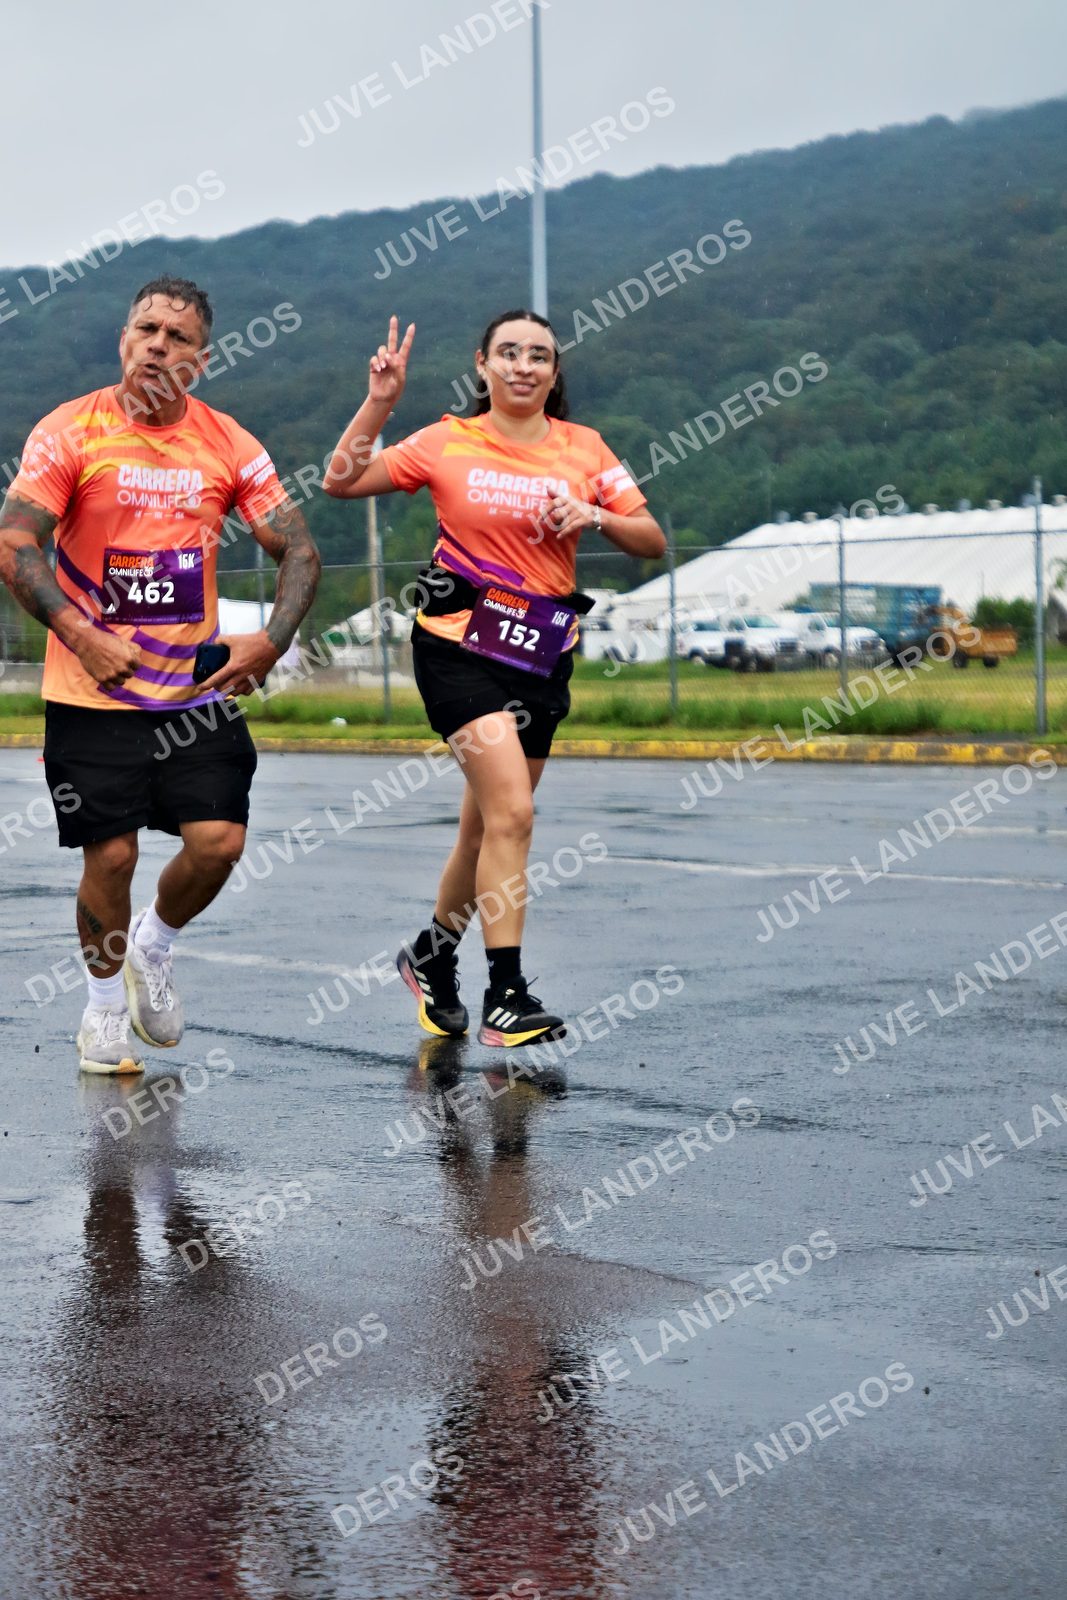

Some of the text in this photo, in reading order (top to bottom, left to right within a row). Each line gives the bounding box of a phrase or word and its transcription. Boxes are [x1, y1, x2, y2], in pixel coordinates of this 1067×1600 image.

[118, 464, 203, 491] CARRERA
[467, 467, 569, 497] CARRERA
[109, 552, 195, 570] CARRERA 16K
[127, 581, 175, 604] 462
[486, 587, 530, 611] CARRERA
[551, 610, 570, 627] 16K
[499, 619, 541, 651] 152
